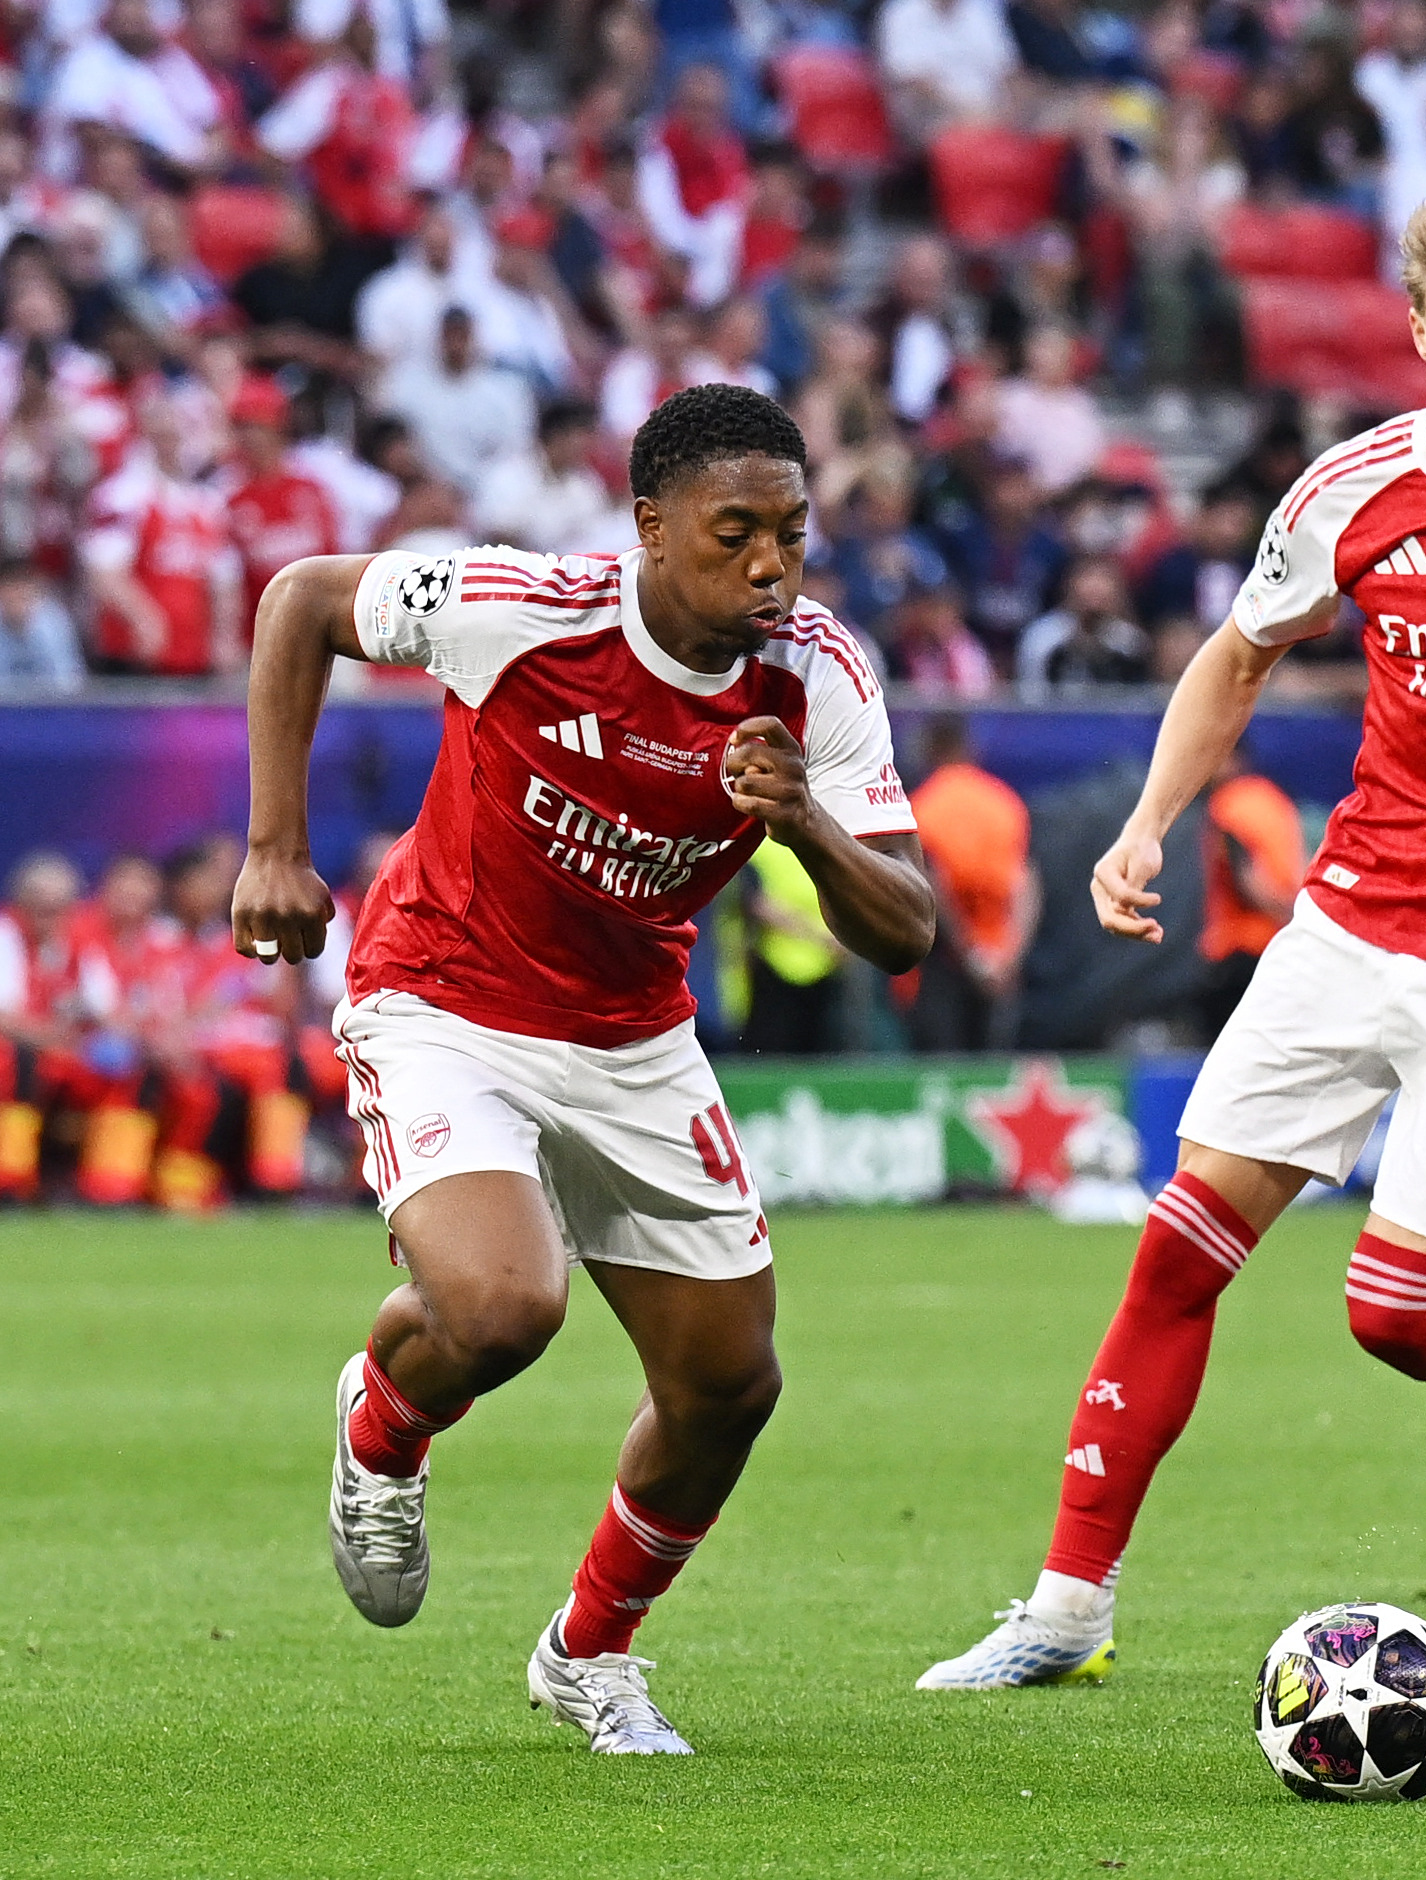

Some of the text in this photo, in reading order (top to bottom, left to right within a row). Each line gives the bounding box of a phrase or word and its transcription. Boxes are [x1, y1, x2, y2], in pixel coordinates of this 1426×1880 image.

[623, 732, 648, 748] FINAL
[649, 741, 693, 762] BUDAPEST
[547, 840, 693, 898] FLY BETTER
